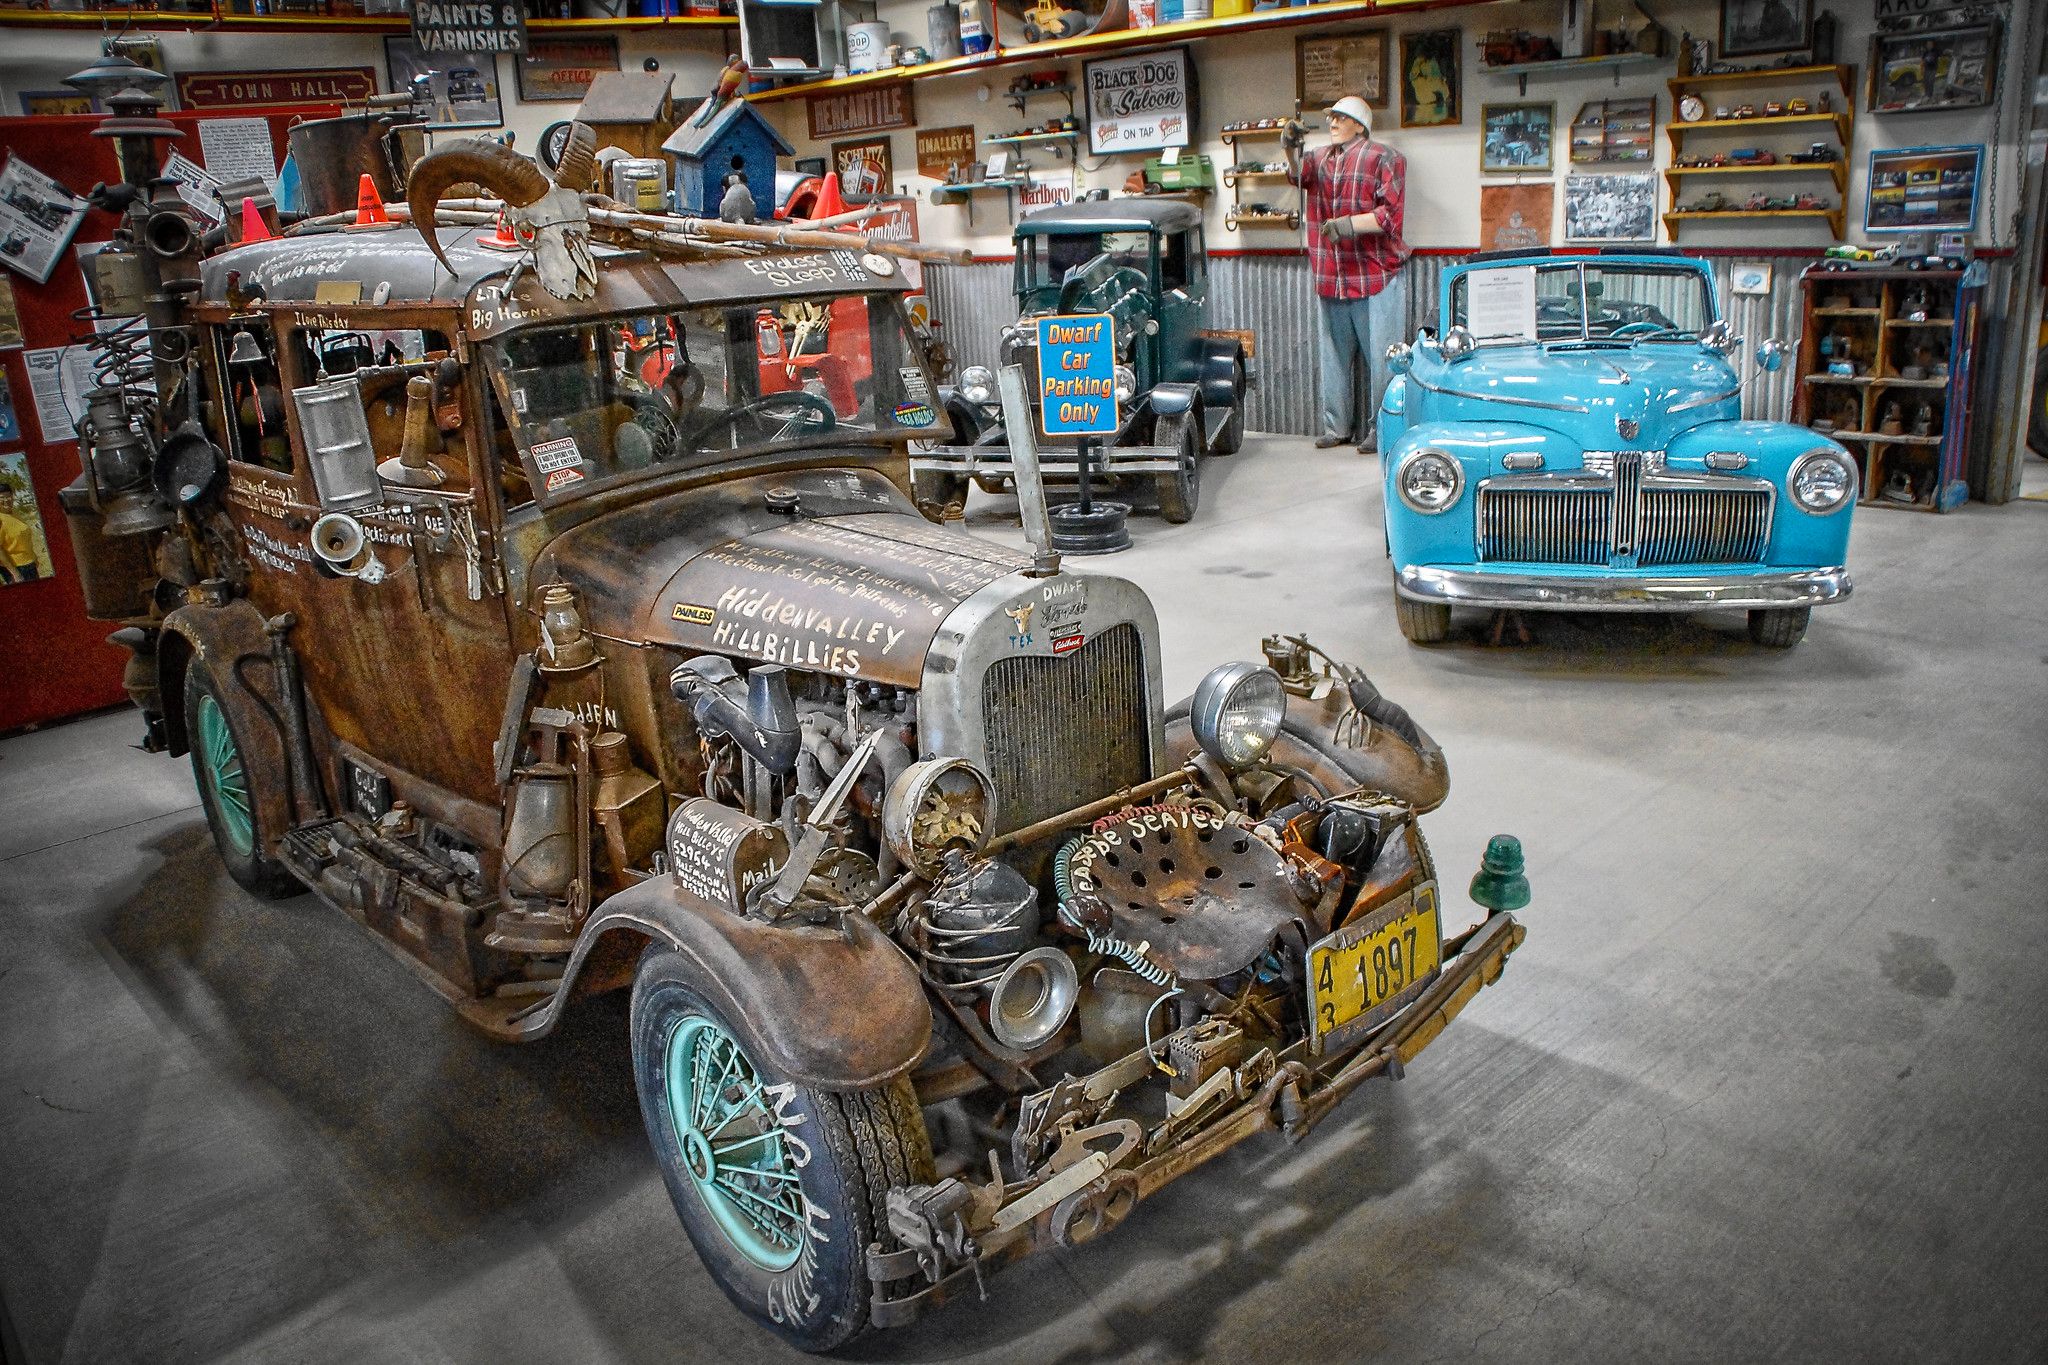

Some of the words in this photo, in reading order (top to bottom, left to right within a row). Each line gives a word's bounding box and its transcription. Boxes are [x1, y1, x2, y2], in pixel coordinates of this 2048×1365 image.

[415, 2, 494, 26] PAINTS
[502, 5, 518, 25] &
[417, 29, 521, 51] VARNISHES
[1092, 69, 1139, 91] BLACK
[1143, 63, 1177, 85] DOG
[217, 83, 273, 99] TOWN
[290, 80, 342, 97] HALL
[813, 87, 904, 133] MERCANTILE
[1114, 87, 1182, 116] Saloon
[1123, 129, 1136, 140] ON
[1138, 127, 1154, 138] TAP
[173, 163, 184, 173] The
[838, 145, 886, 173] SCHLITZ
[1019, 183, 1071, 206] Marlboro
[472, 309, 494, 330] Big
[1047, 322, 1103, 346] Dwarf
[1061, 350, 1093, 371] Car
[1043, 375, 1114, 399] Parking
[1059, 401, 1101, 425] Only
[533, 440, 572, 454] WARNING
[552, 470, 571, 481] STOP
[674, 605, 714, 622] PAINLESS
[1008, 632, 1034, 650] TEX
[673, 839, 711, 871] 52954
[742, 857, 776, 893] Mail
[1358, 926, 1418, 1012] 1897
